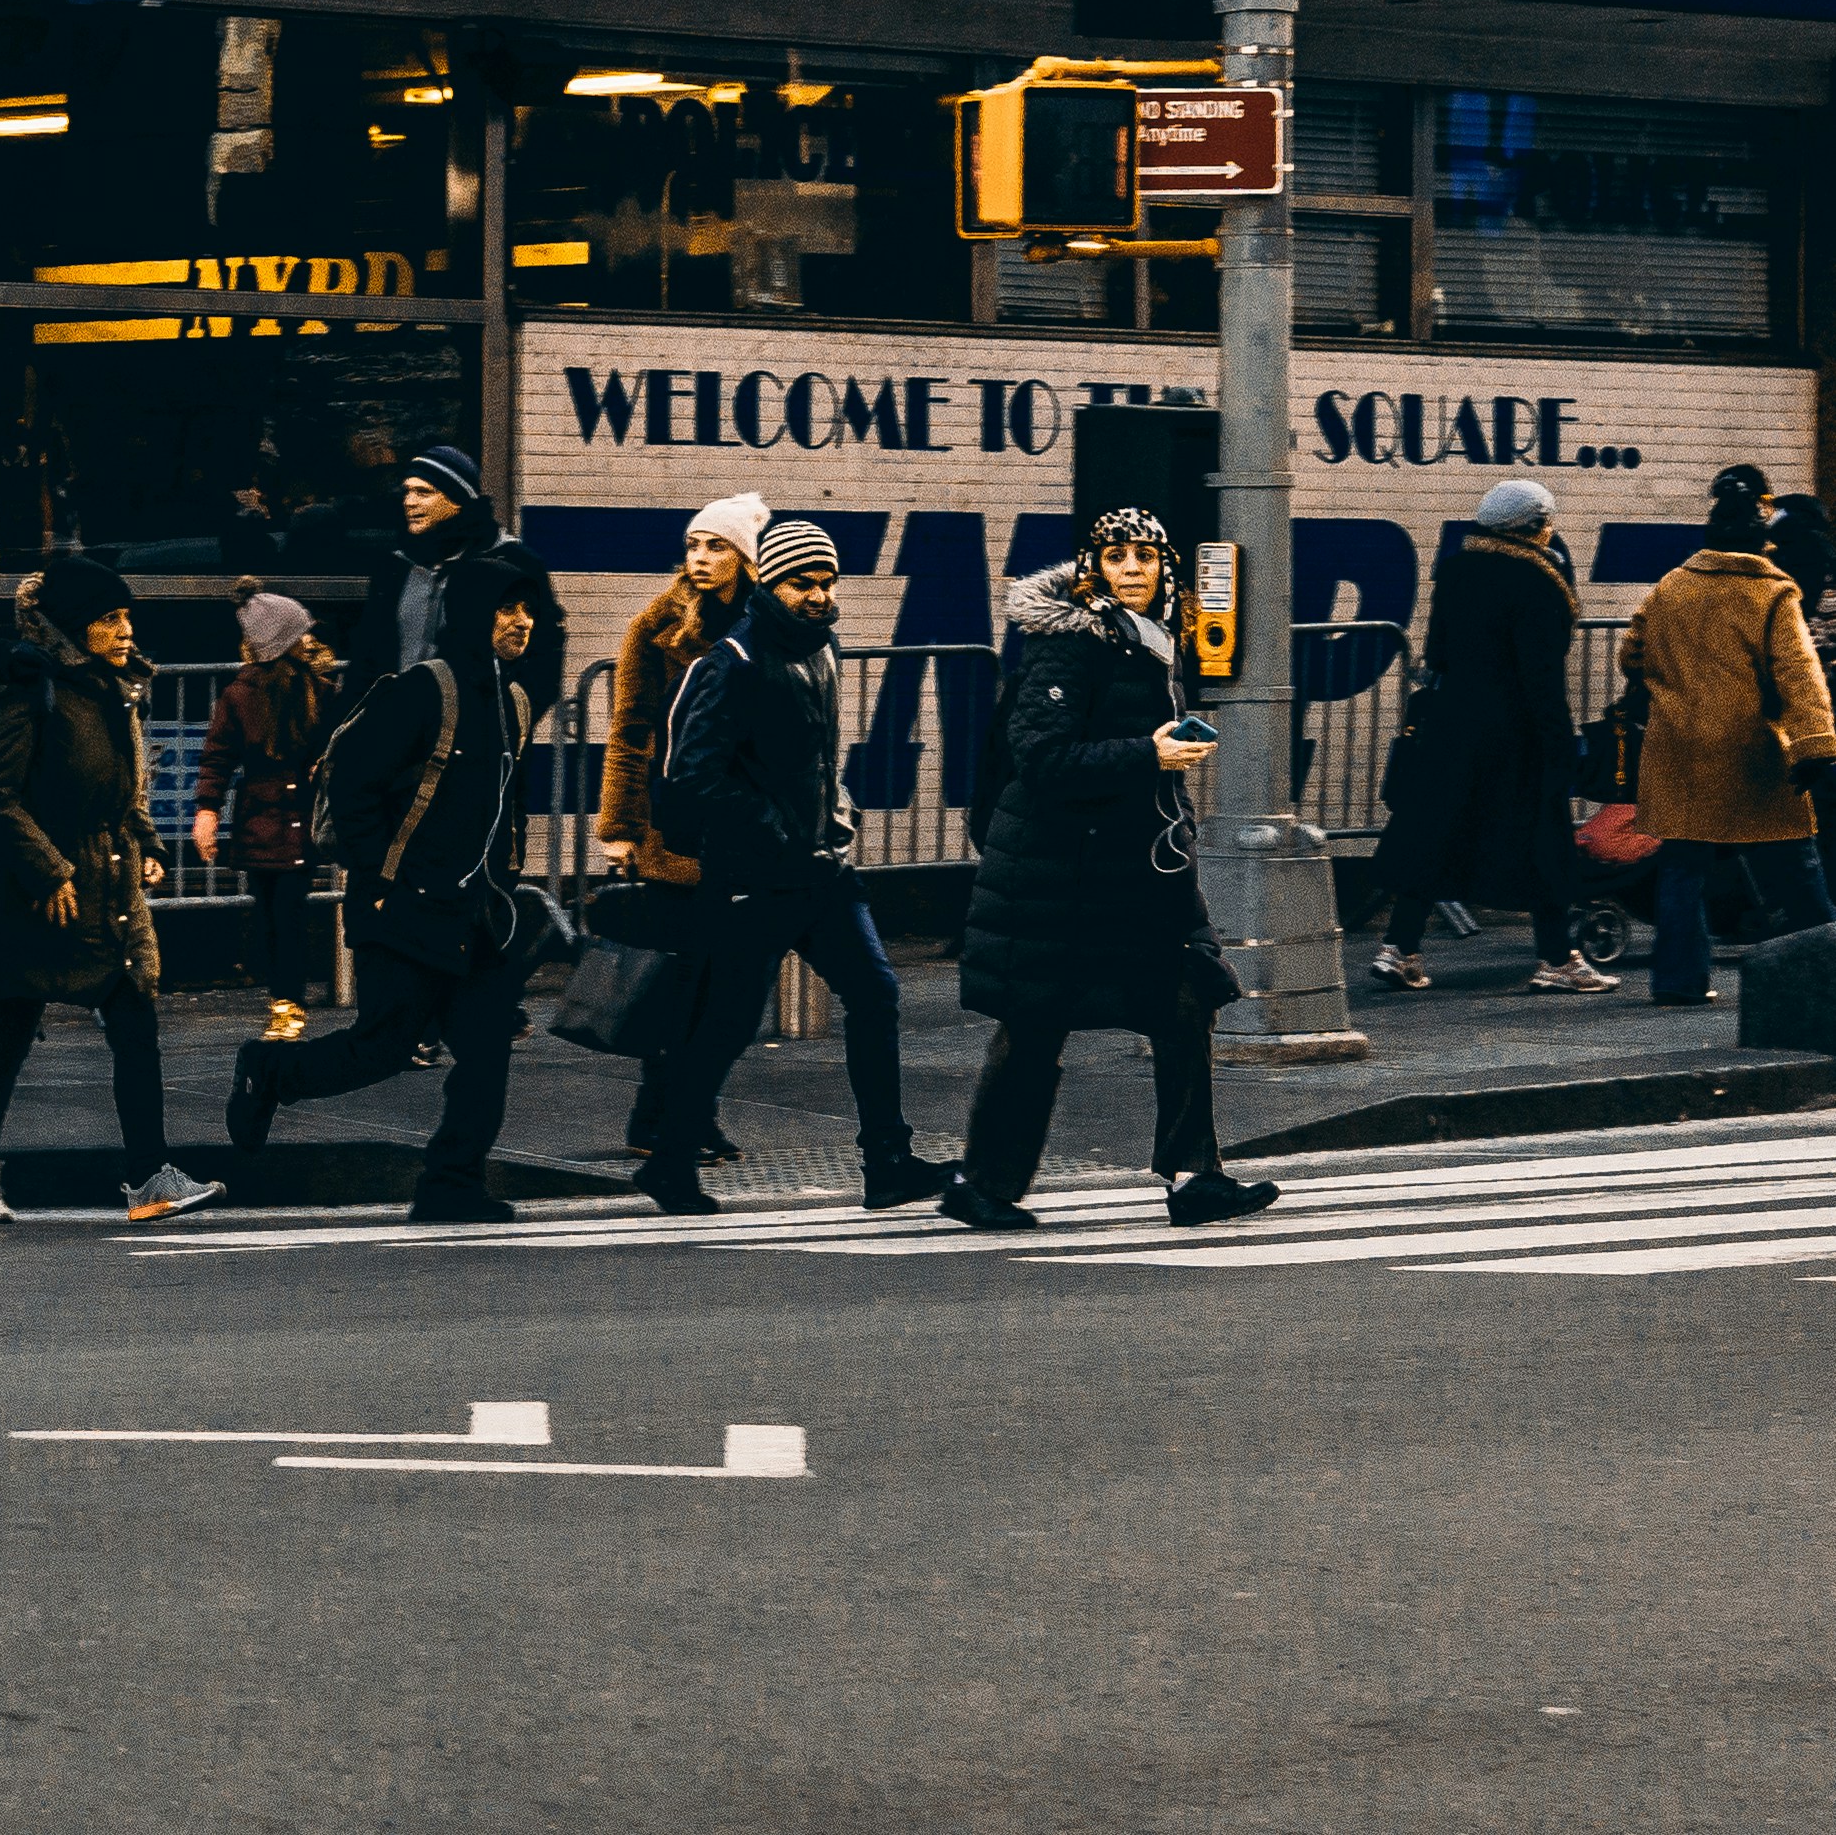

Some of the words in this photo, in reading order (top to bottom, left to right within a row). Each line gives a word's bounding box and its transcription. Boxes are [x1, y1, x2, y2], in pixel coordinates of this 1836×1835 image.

[186, 251, 416, 338] NYPD
[563, 366, 952, 452] WELCOME
[968, 378, 1062, 456] TO
